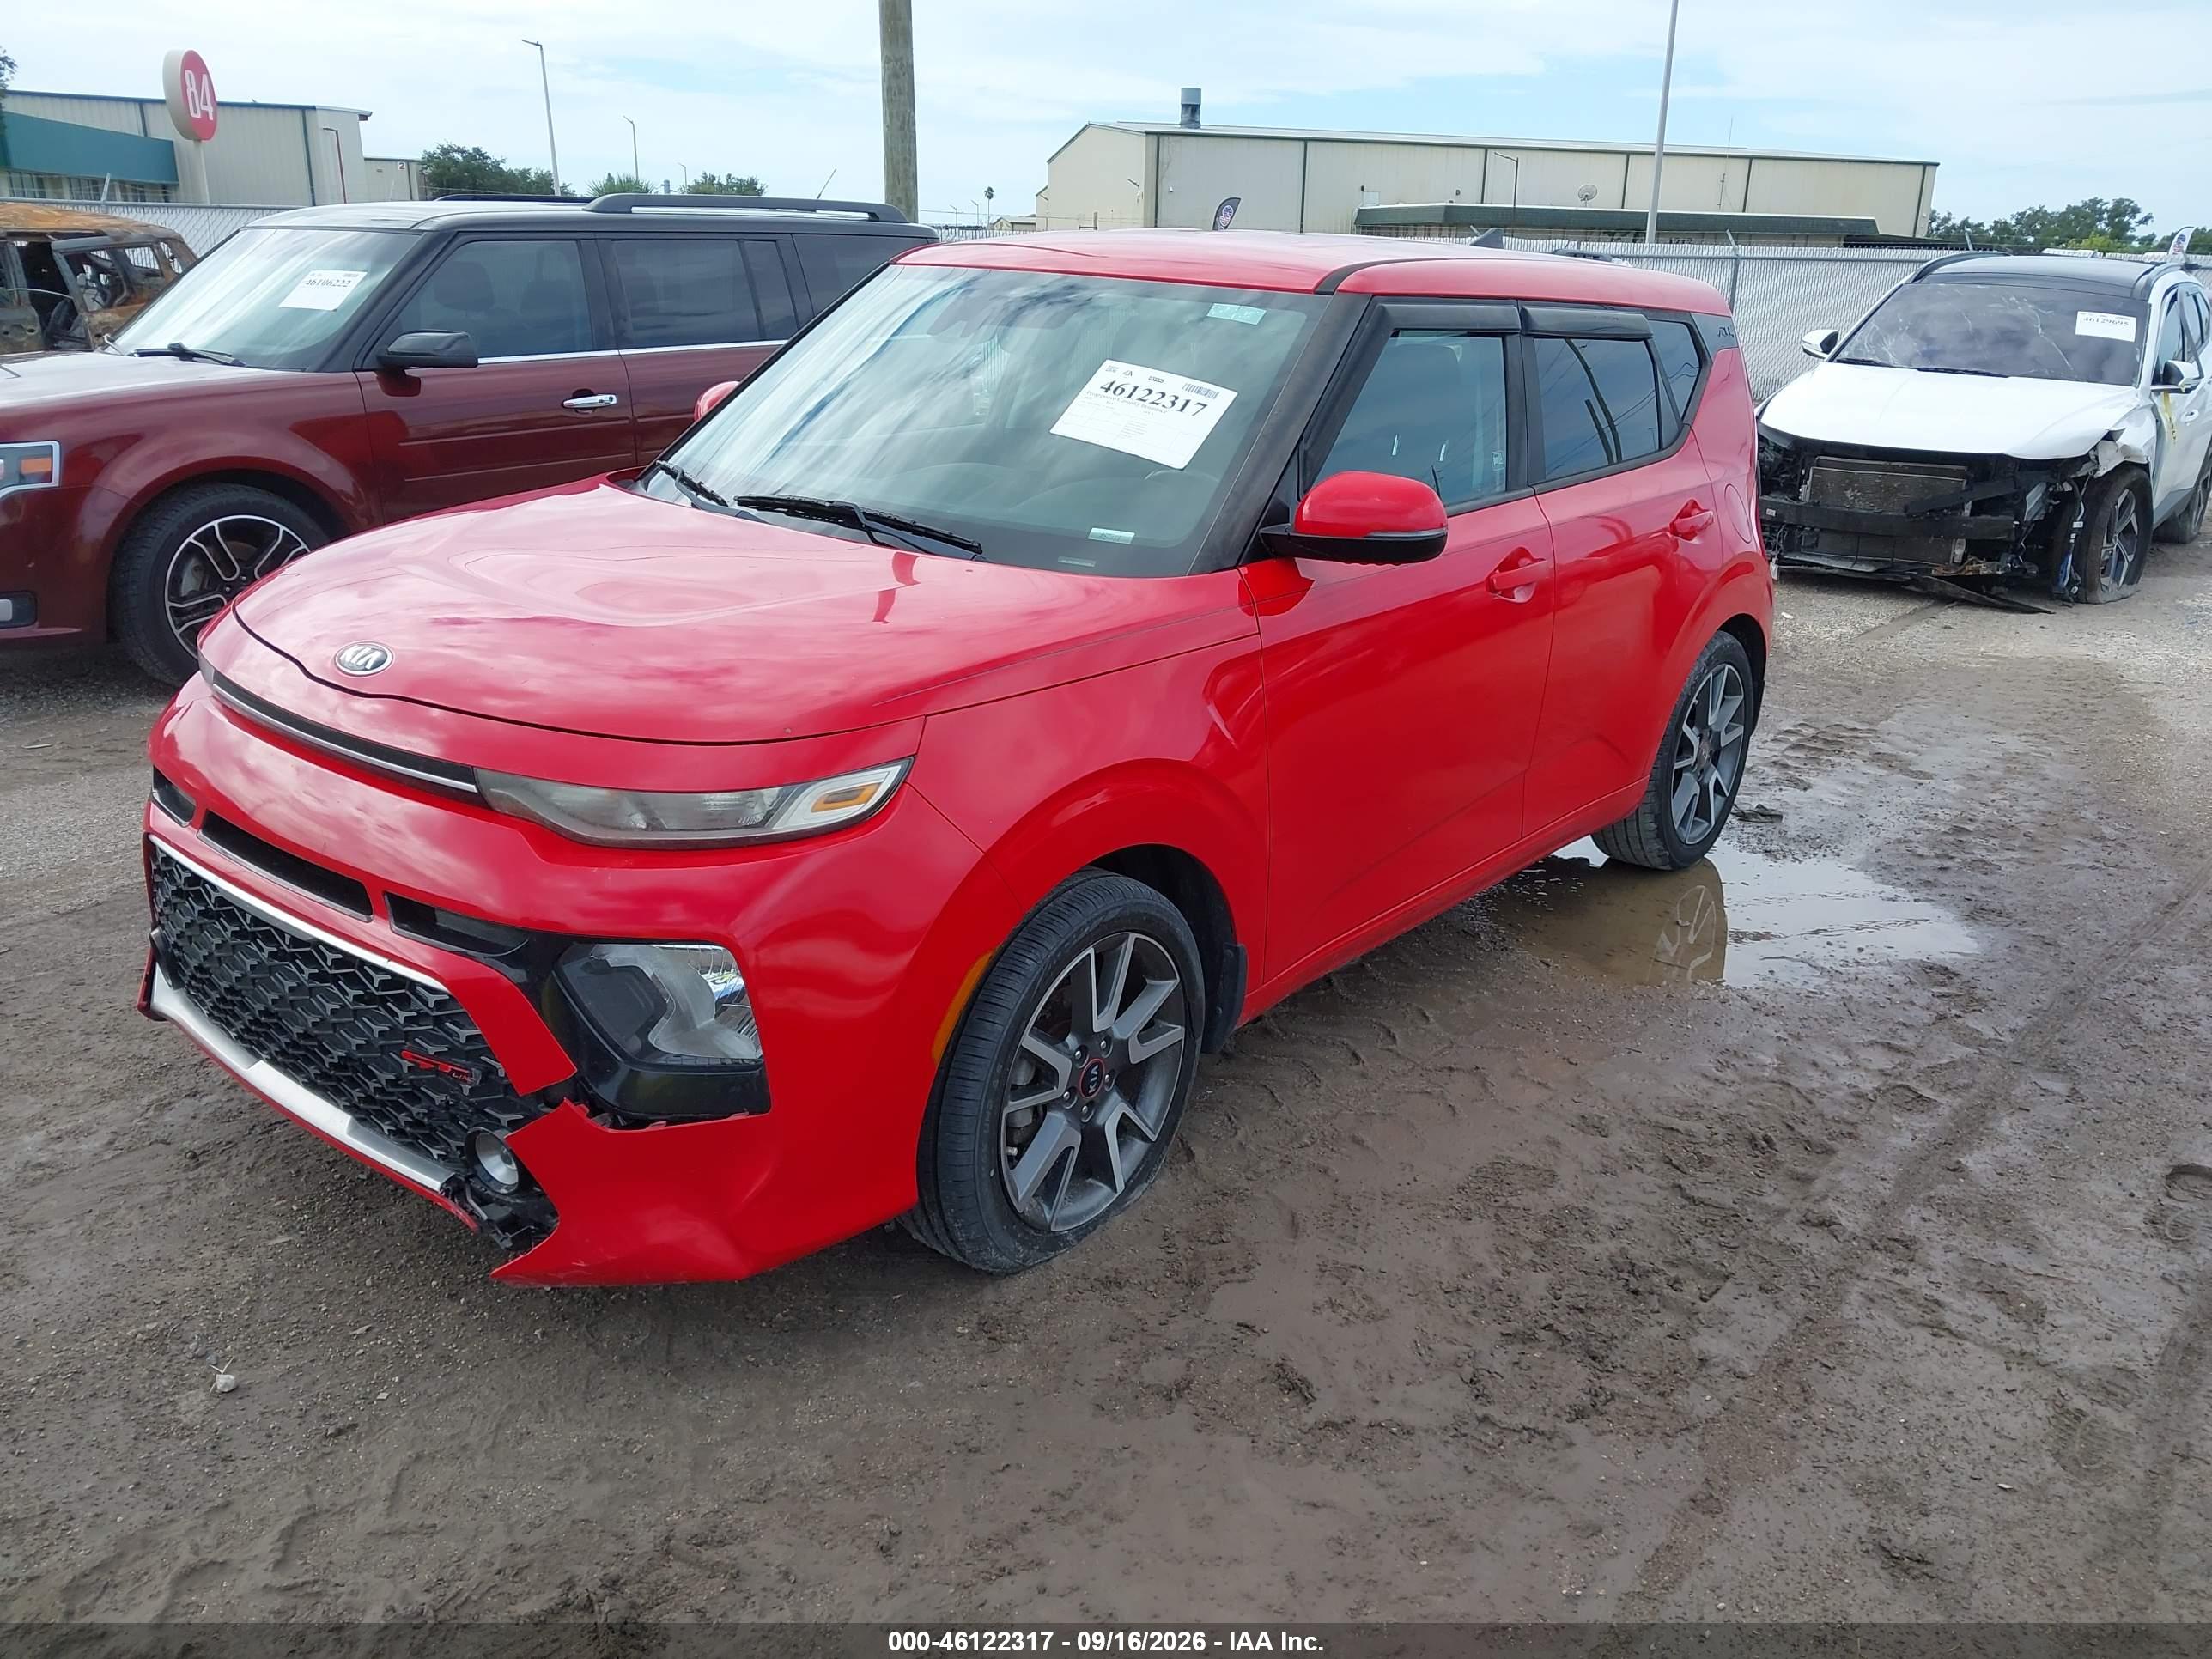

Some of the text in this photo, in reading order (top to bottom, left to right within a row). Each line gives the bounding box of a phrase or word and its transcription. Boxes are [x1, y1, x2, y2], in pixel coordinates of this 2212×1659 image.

[185, 70, 213, 120] 84
[1100, 380, 1207, 416] 46122317
[339, 646, 383, 670] KIA
[1088, 1064, 1099, 1094] KIA
